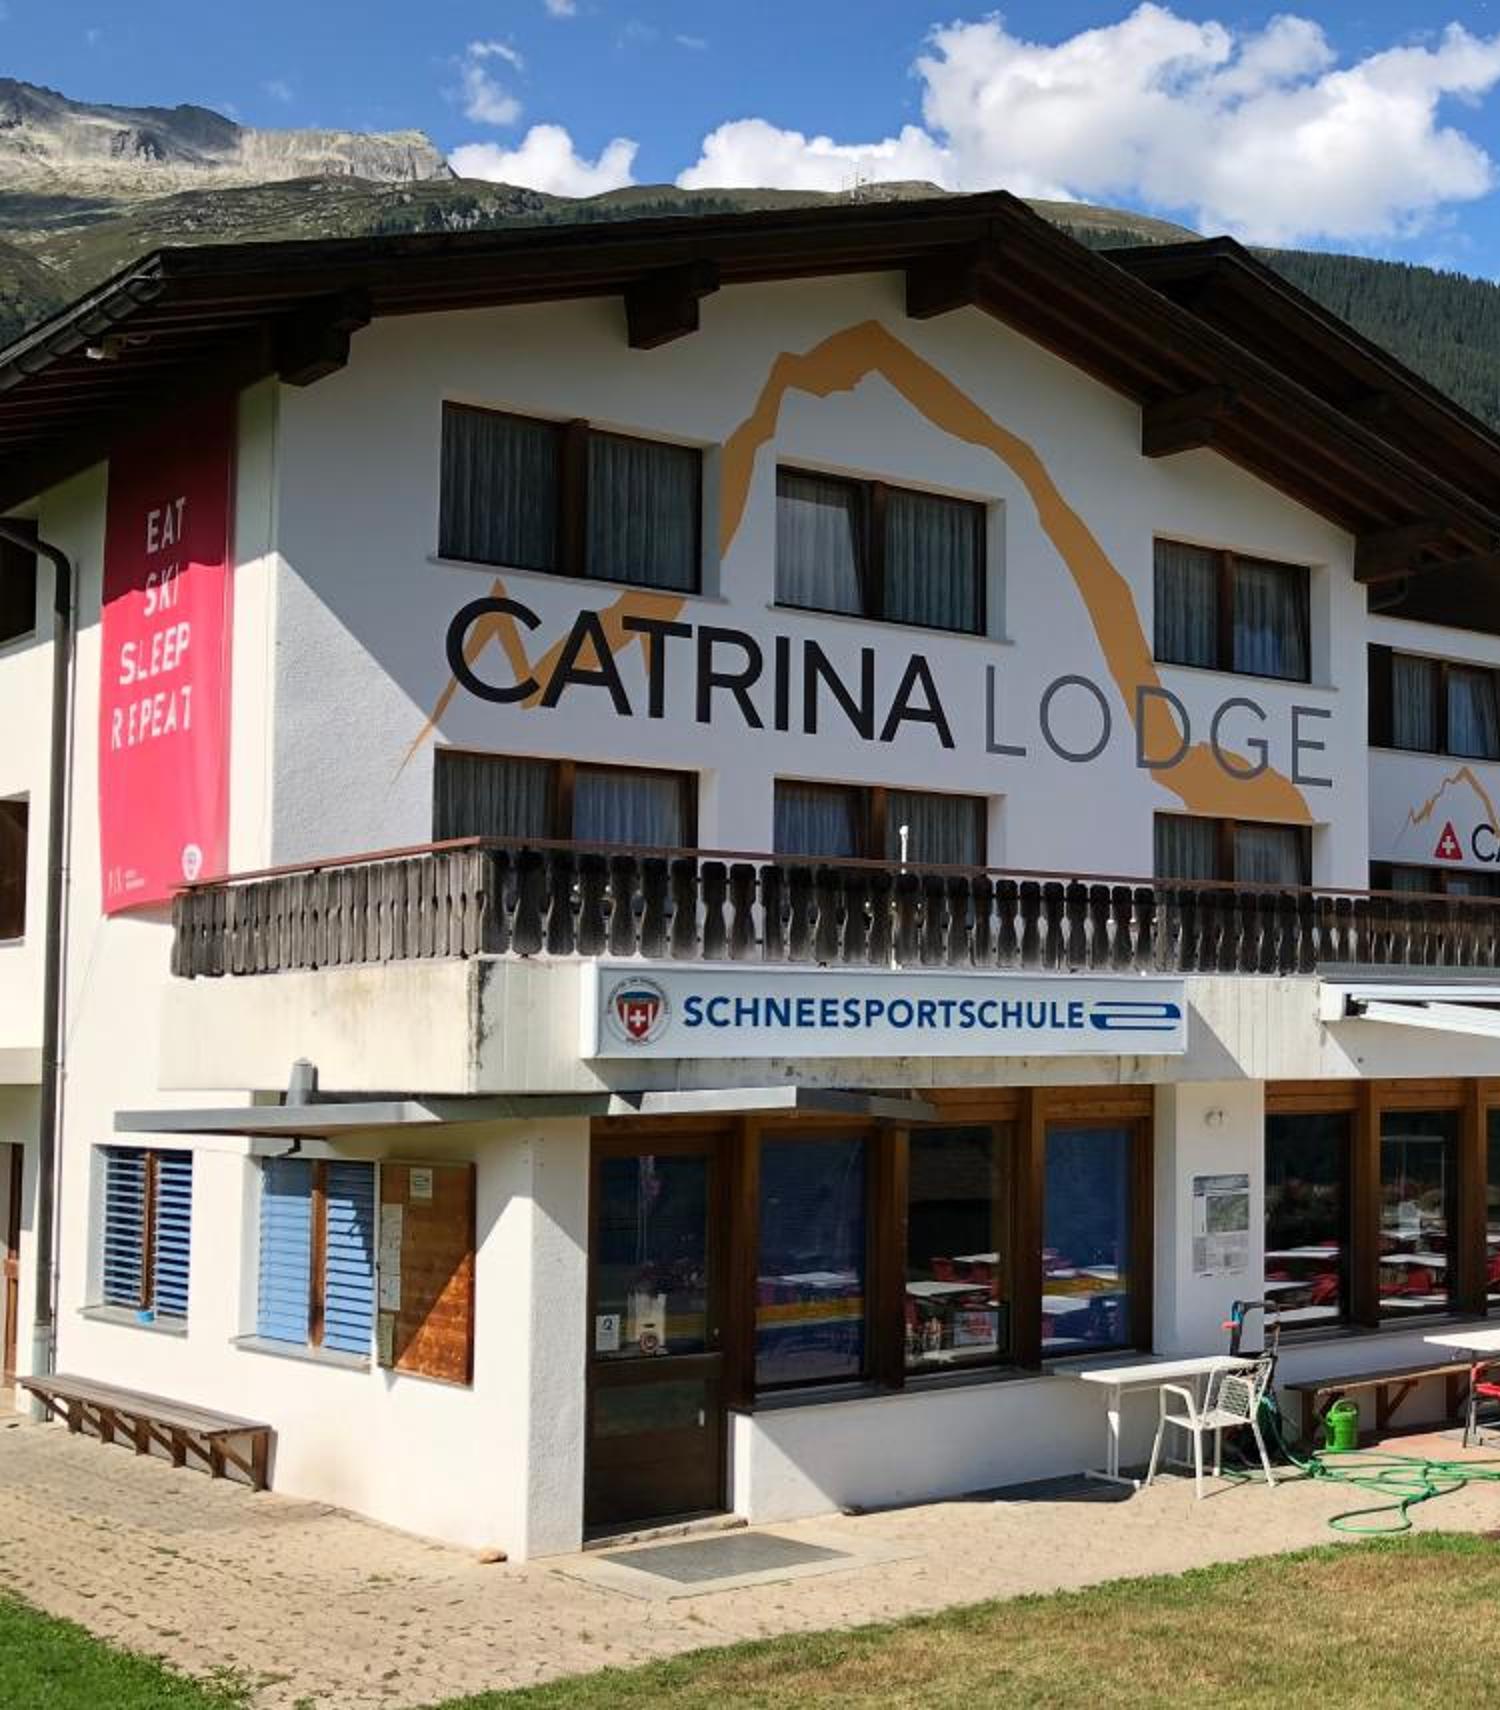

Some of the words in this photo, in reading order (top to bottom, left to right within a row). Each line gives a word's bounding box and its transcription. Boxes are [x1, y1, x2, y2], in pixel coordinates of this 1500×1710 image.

[147, 497, 187, 553] EAT
[143, 562, 180, 616] SKI
[120, 623, 190, 685] SLEEP
[112, 687, 192, 750] REPEAT
[446, 597, 956, 748] CATRINA
[986, 665, 1332, 787] LODGE
[683, 995, 1084, 1029] SCHNEESPORTSCHULE
